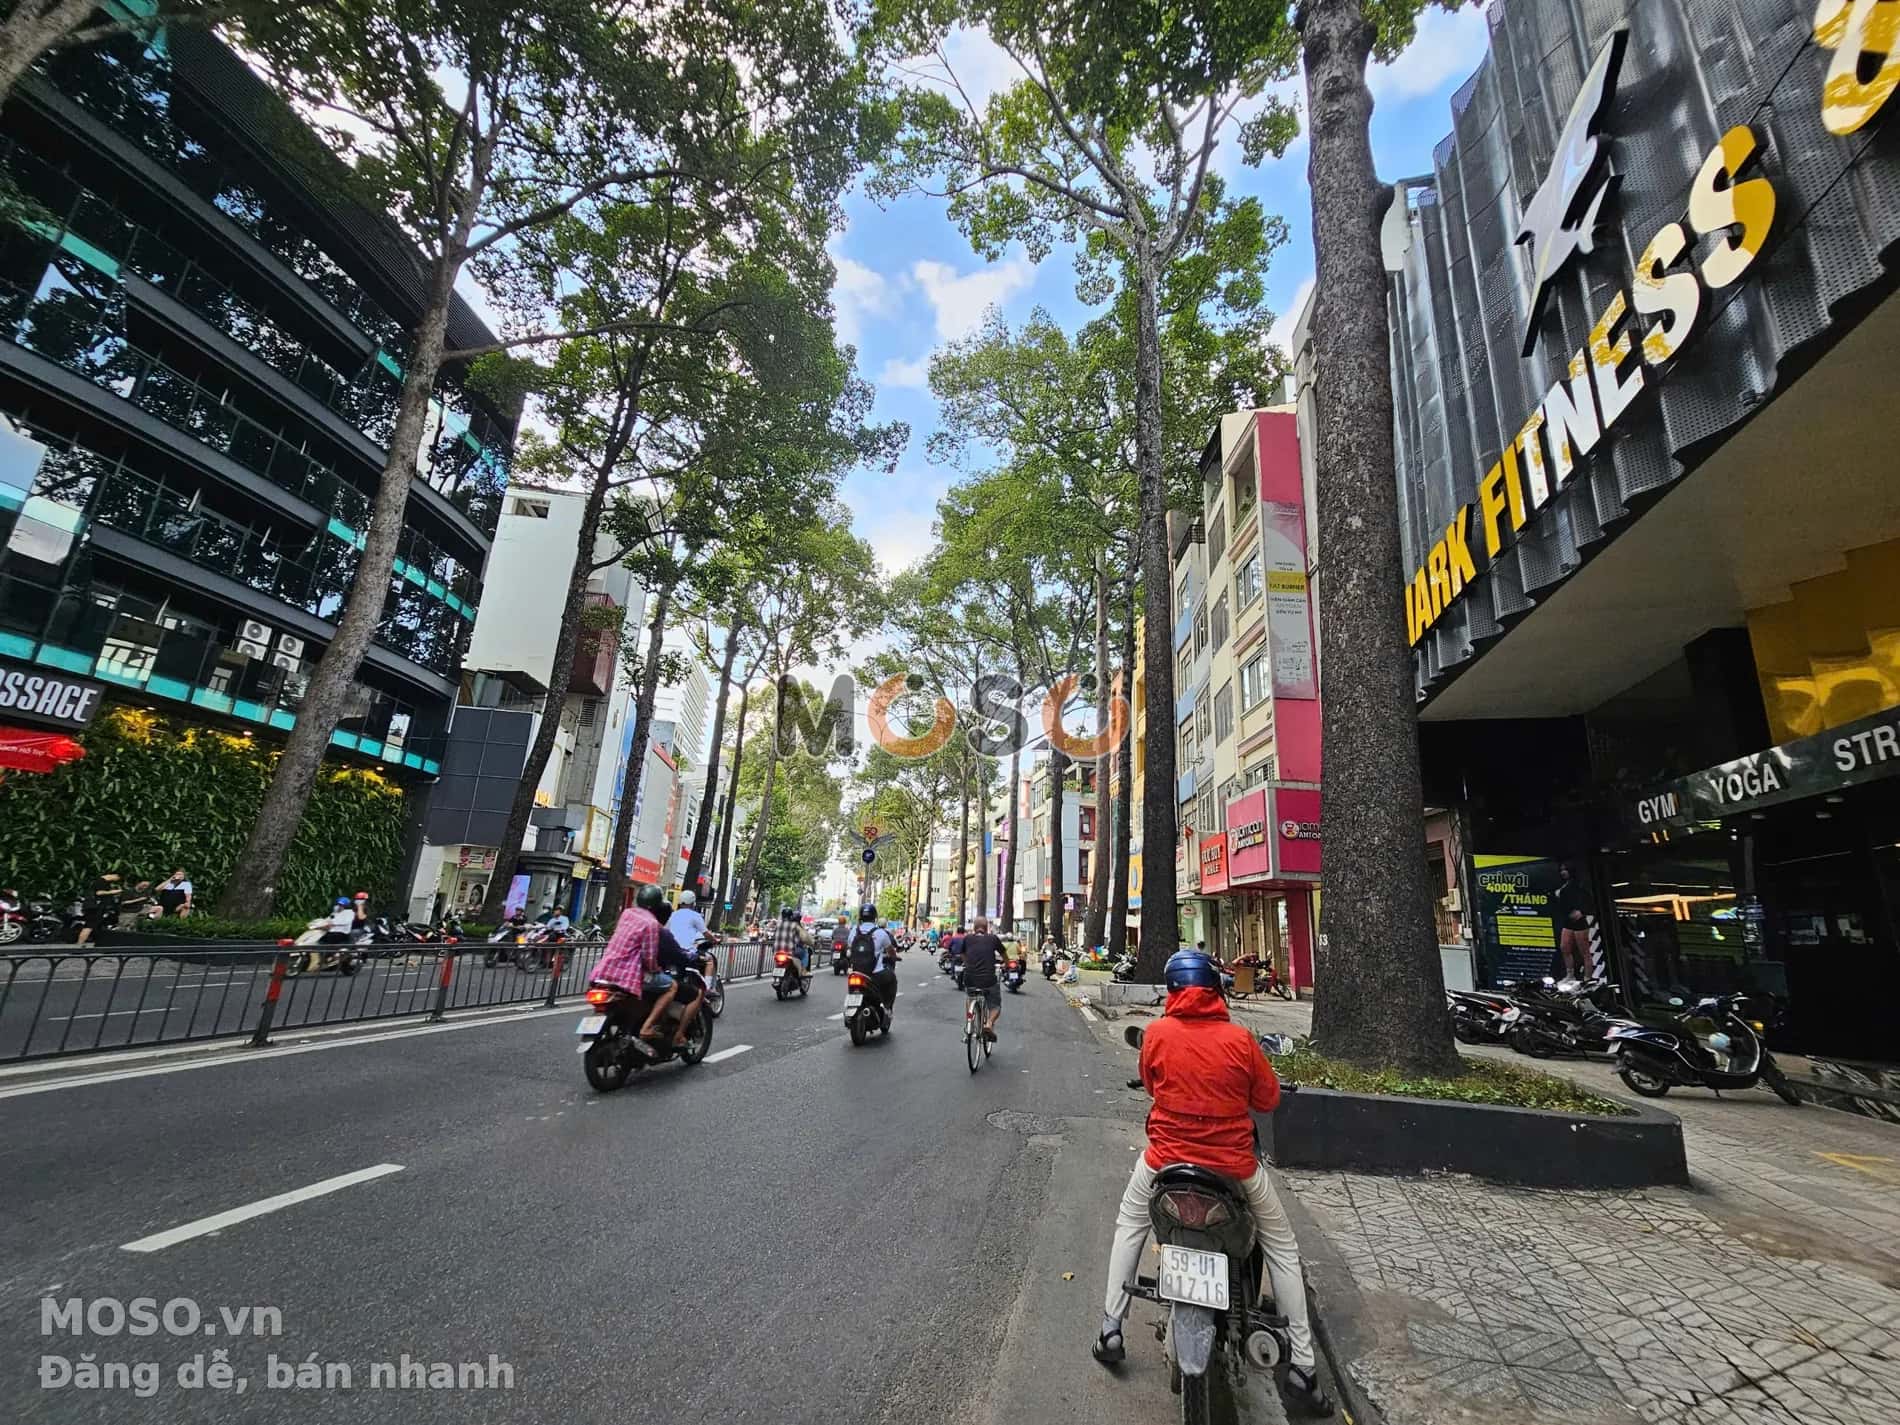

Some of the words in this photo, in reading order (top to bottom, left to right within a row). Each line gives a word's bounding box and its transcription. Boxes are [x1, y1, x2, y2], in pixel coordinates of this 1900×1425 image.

[1478, 124, 1777, 560] FITNESS
[1833, 720, 1900, 772] STR
[1710, 762, 1781, 805] YOGA
[1637, 792, 1677, 825] GYM
[1486, 882, 1516, 894] 400K
